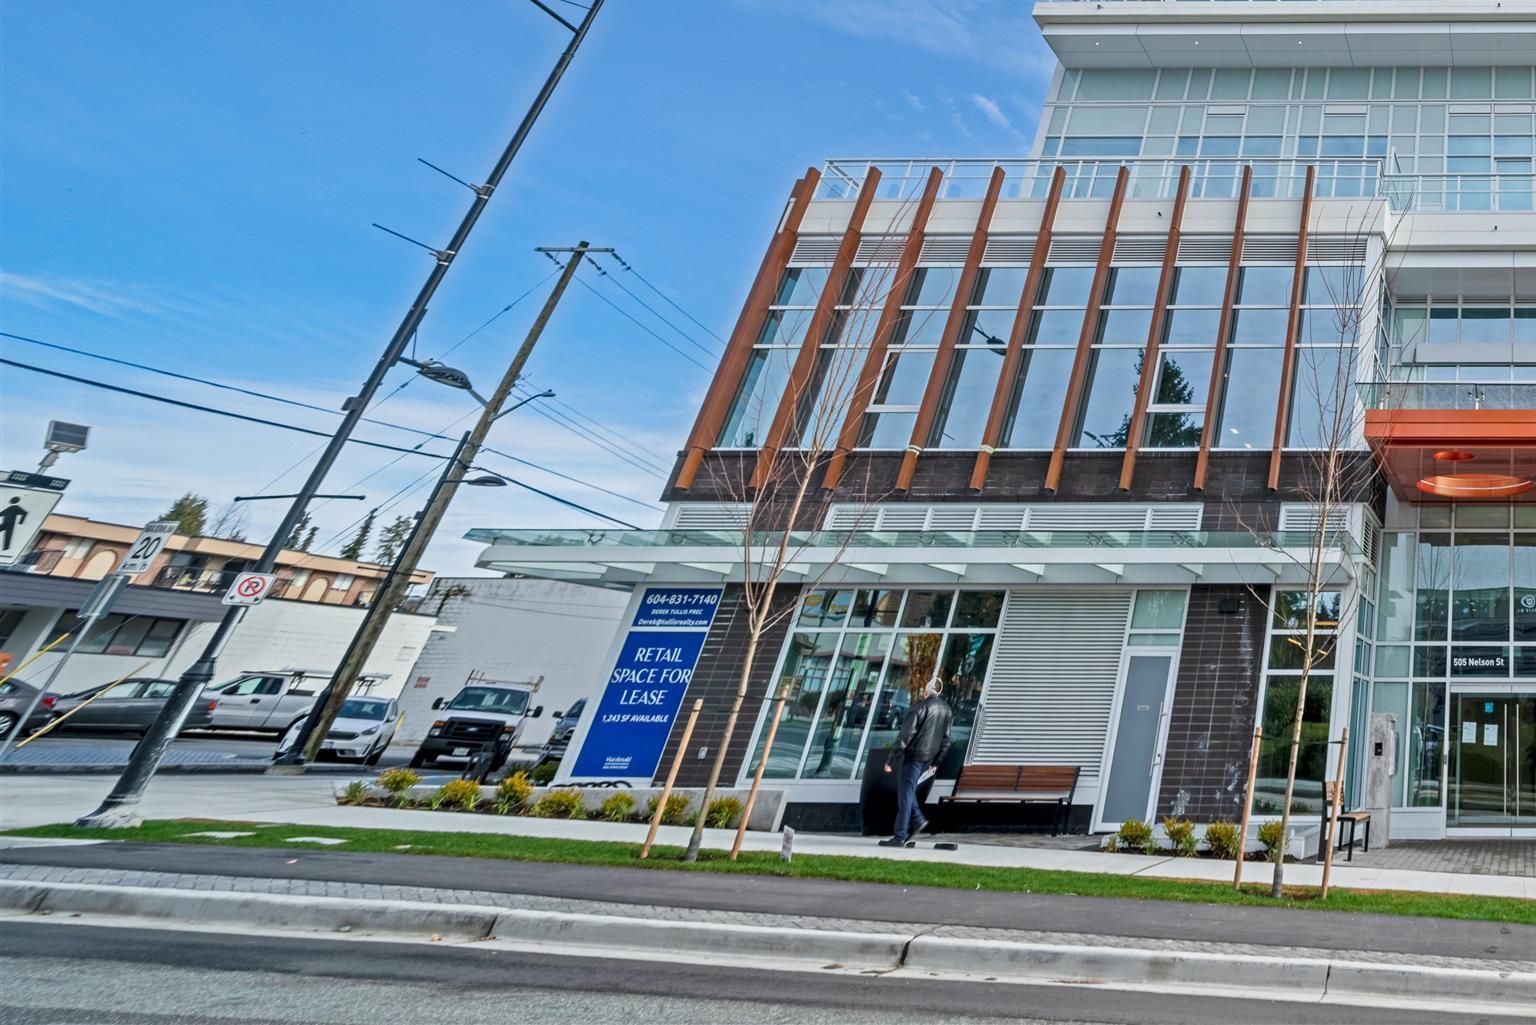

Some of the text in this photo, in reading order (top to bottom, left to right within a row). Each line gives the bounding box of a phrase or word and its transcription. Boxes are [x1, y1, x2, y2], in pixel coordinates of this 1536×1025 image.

[131, 536, 161, 559] 20
[646, 594, 718, 605] 604-831-7140
[634, 647, 683, 663] RETAIL
[1453, 658, 1504, 667] 505 Nelson St
[611, 668, 692, 684] SPACE FOR
[620, 689, 668, 705] LEASE
[602, 714, 669, 724] 1,243 SF AVAILABLE
